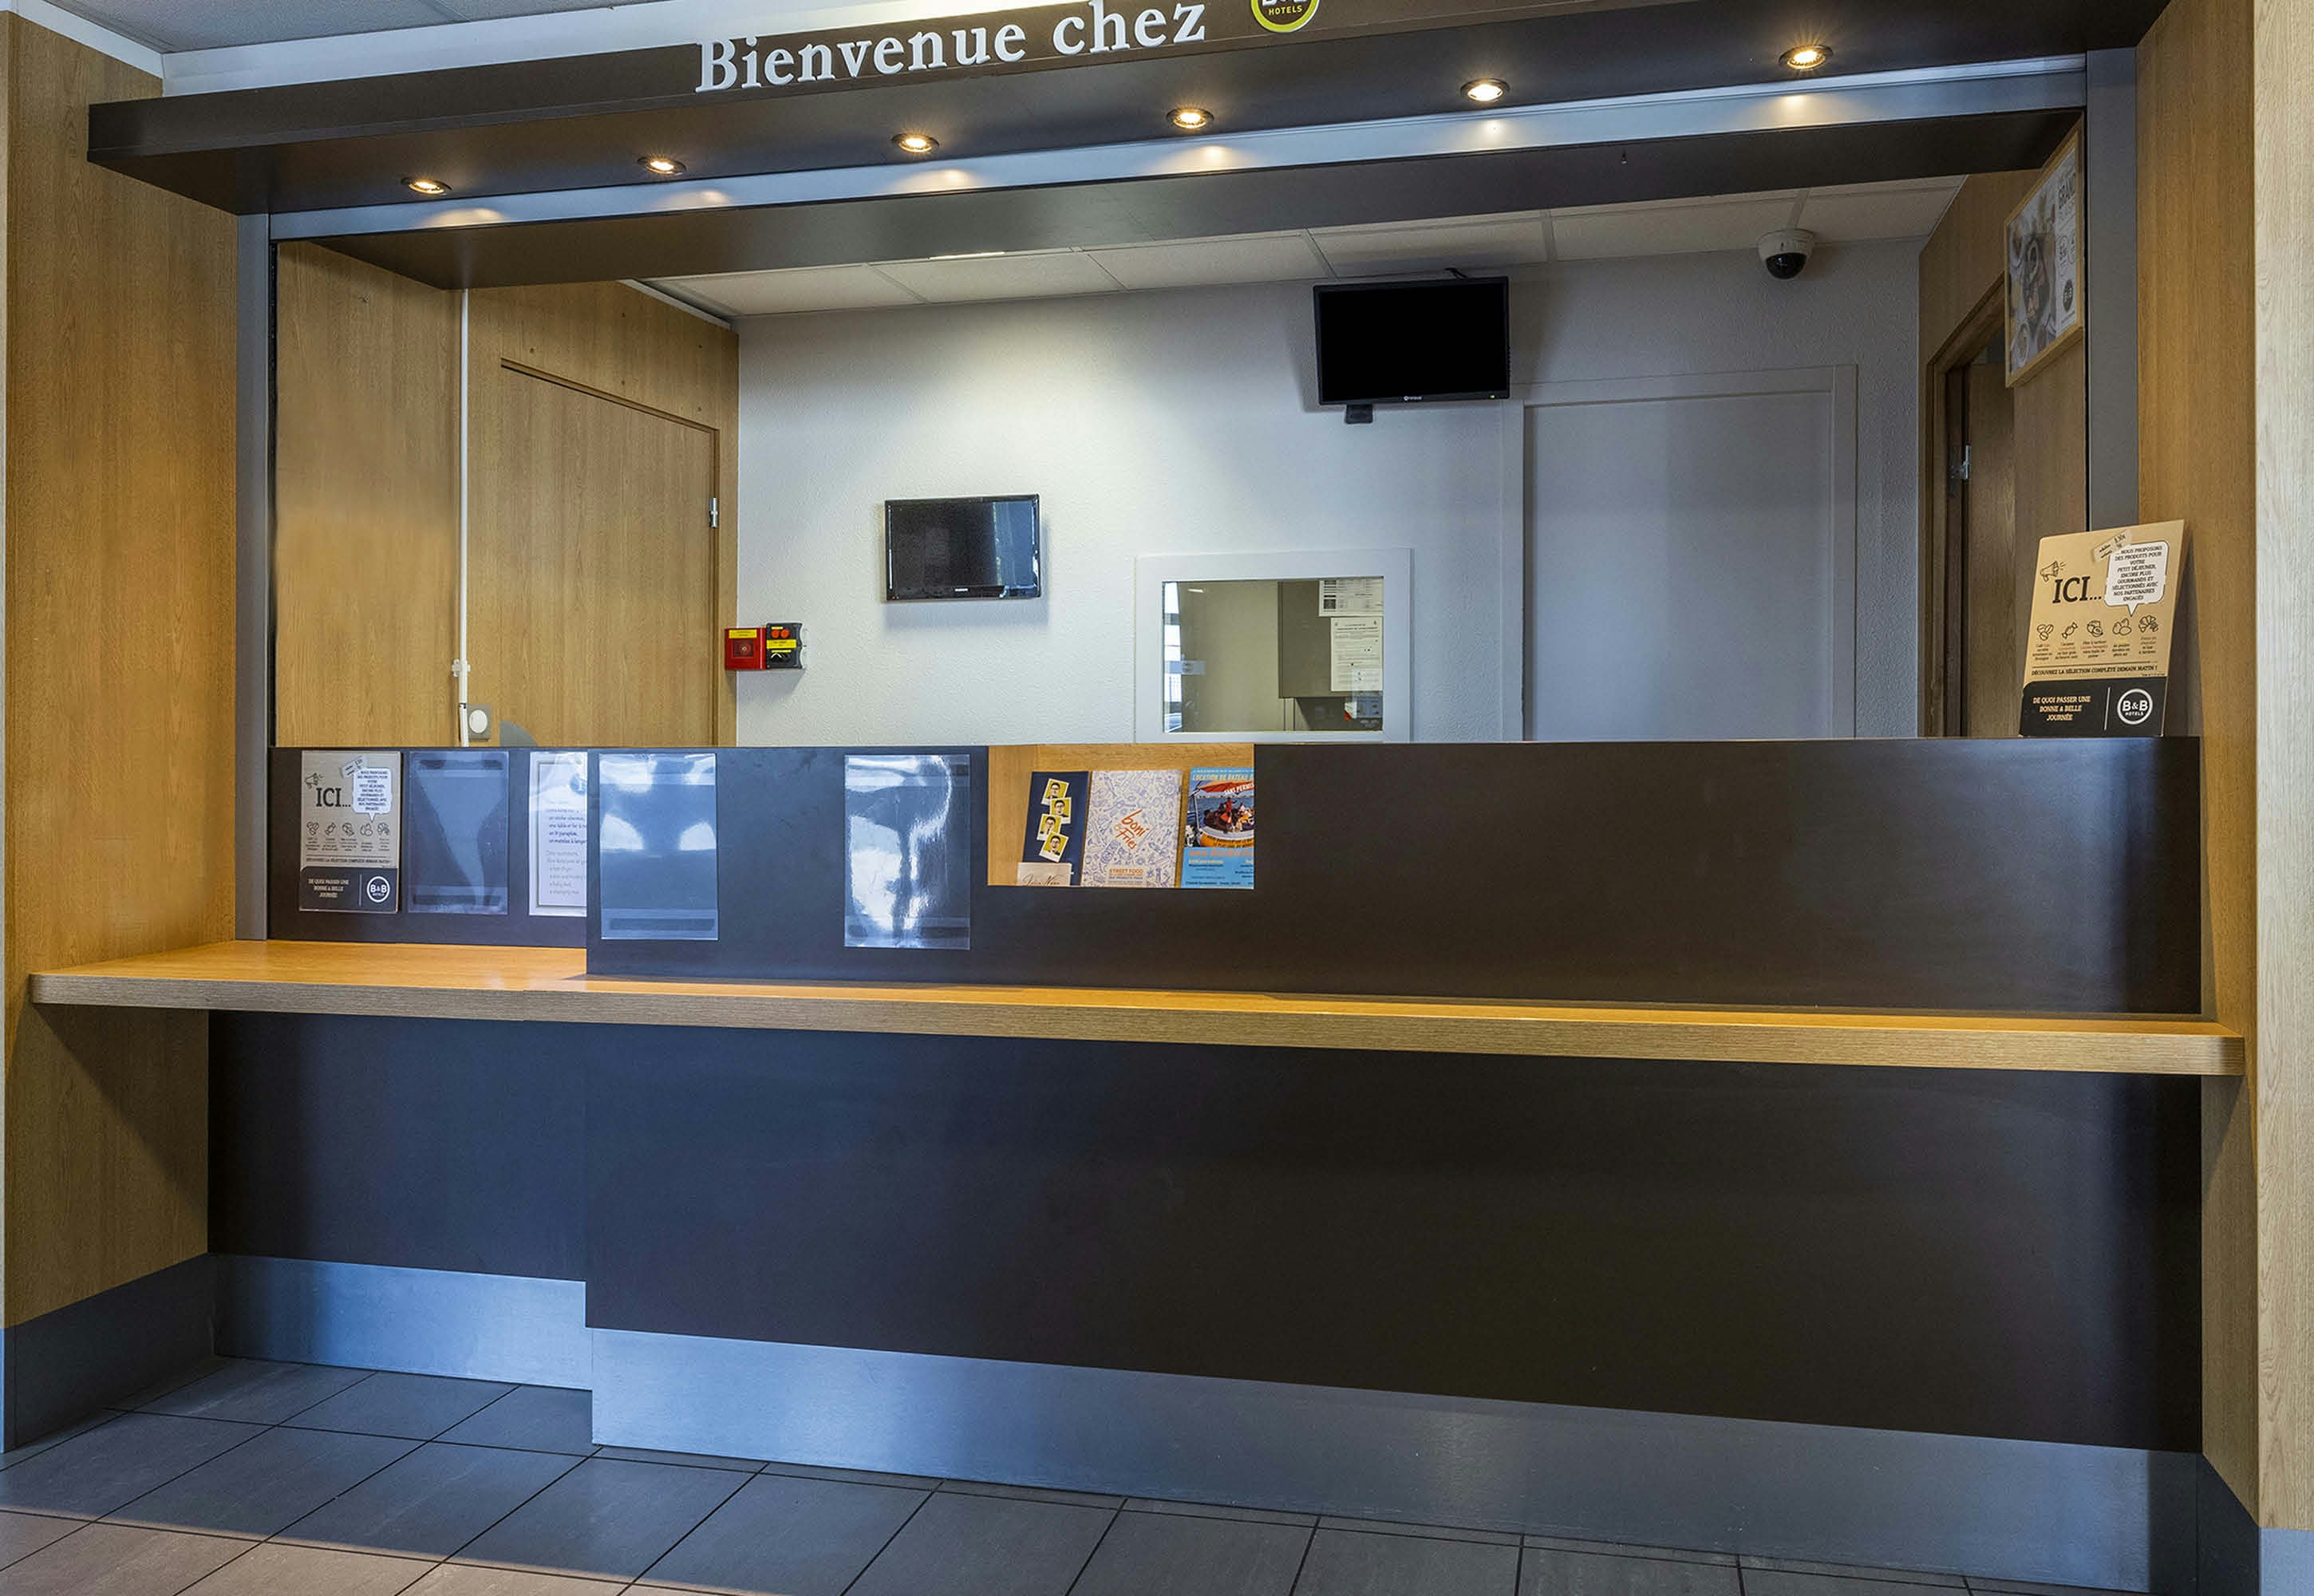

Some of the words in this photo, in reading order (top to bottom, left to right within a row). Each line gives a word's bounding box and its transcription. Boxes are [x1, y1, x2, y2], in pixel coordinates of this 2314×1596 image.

[1269, 5, 1302, 15] HOTELS
[695, 24, 1026, 93] Bienvenue
[1052, 0, 1206, 56] chez
[2122, 699, 2149, 713] B&B
[370, 884, 387, 893] B&B
